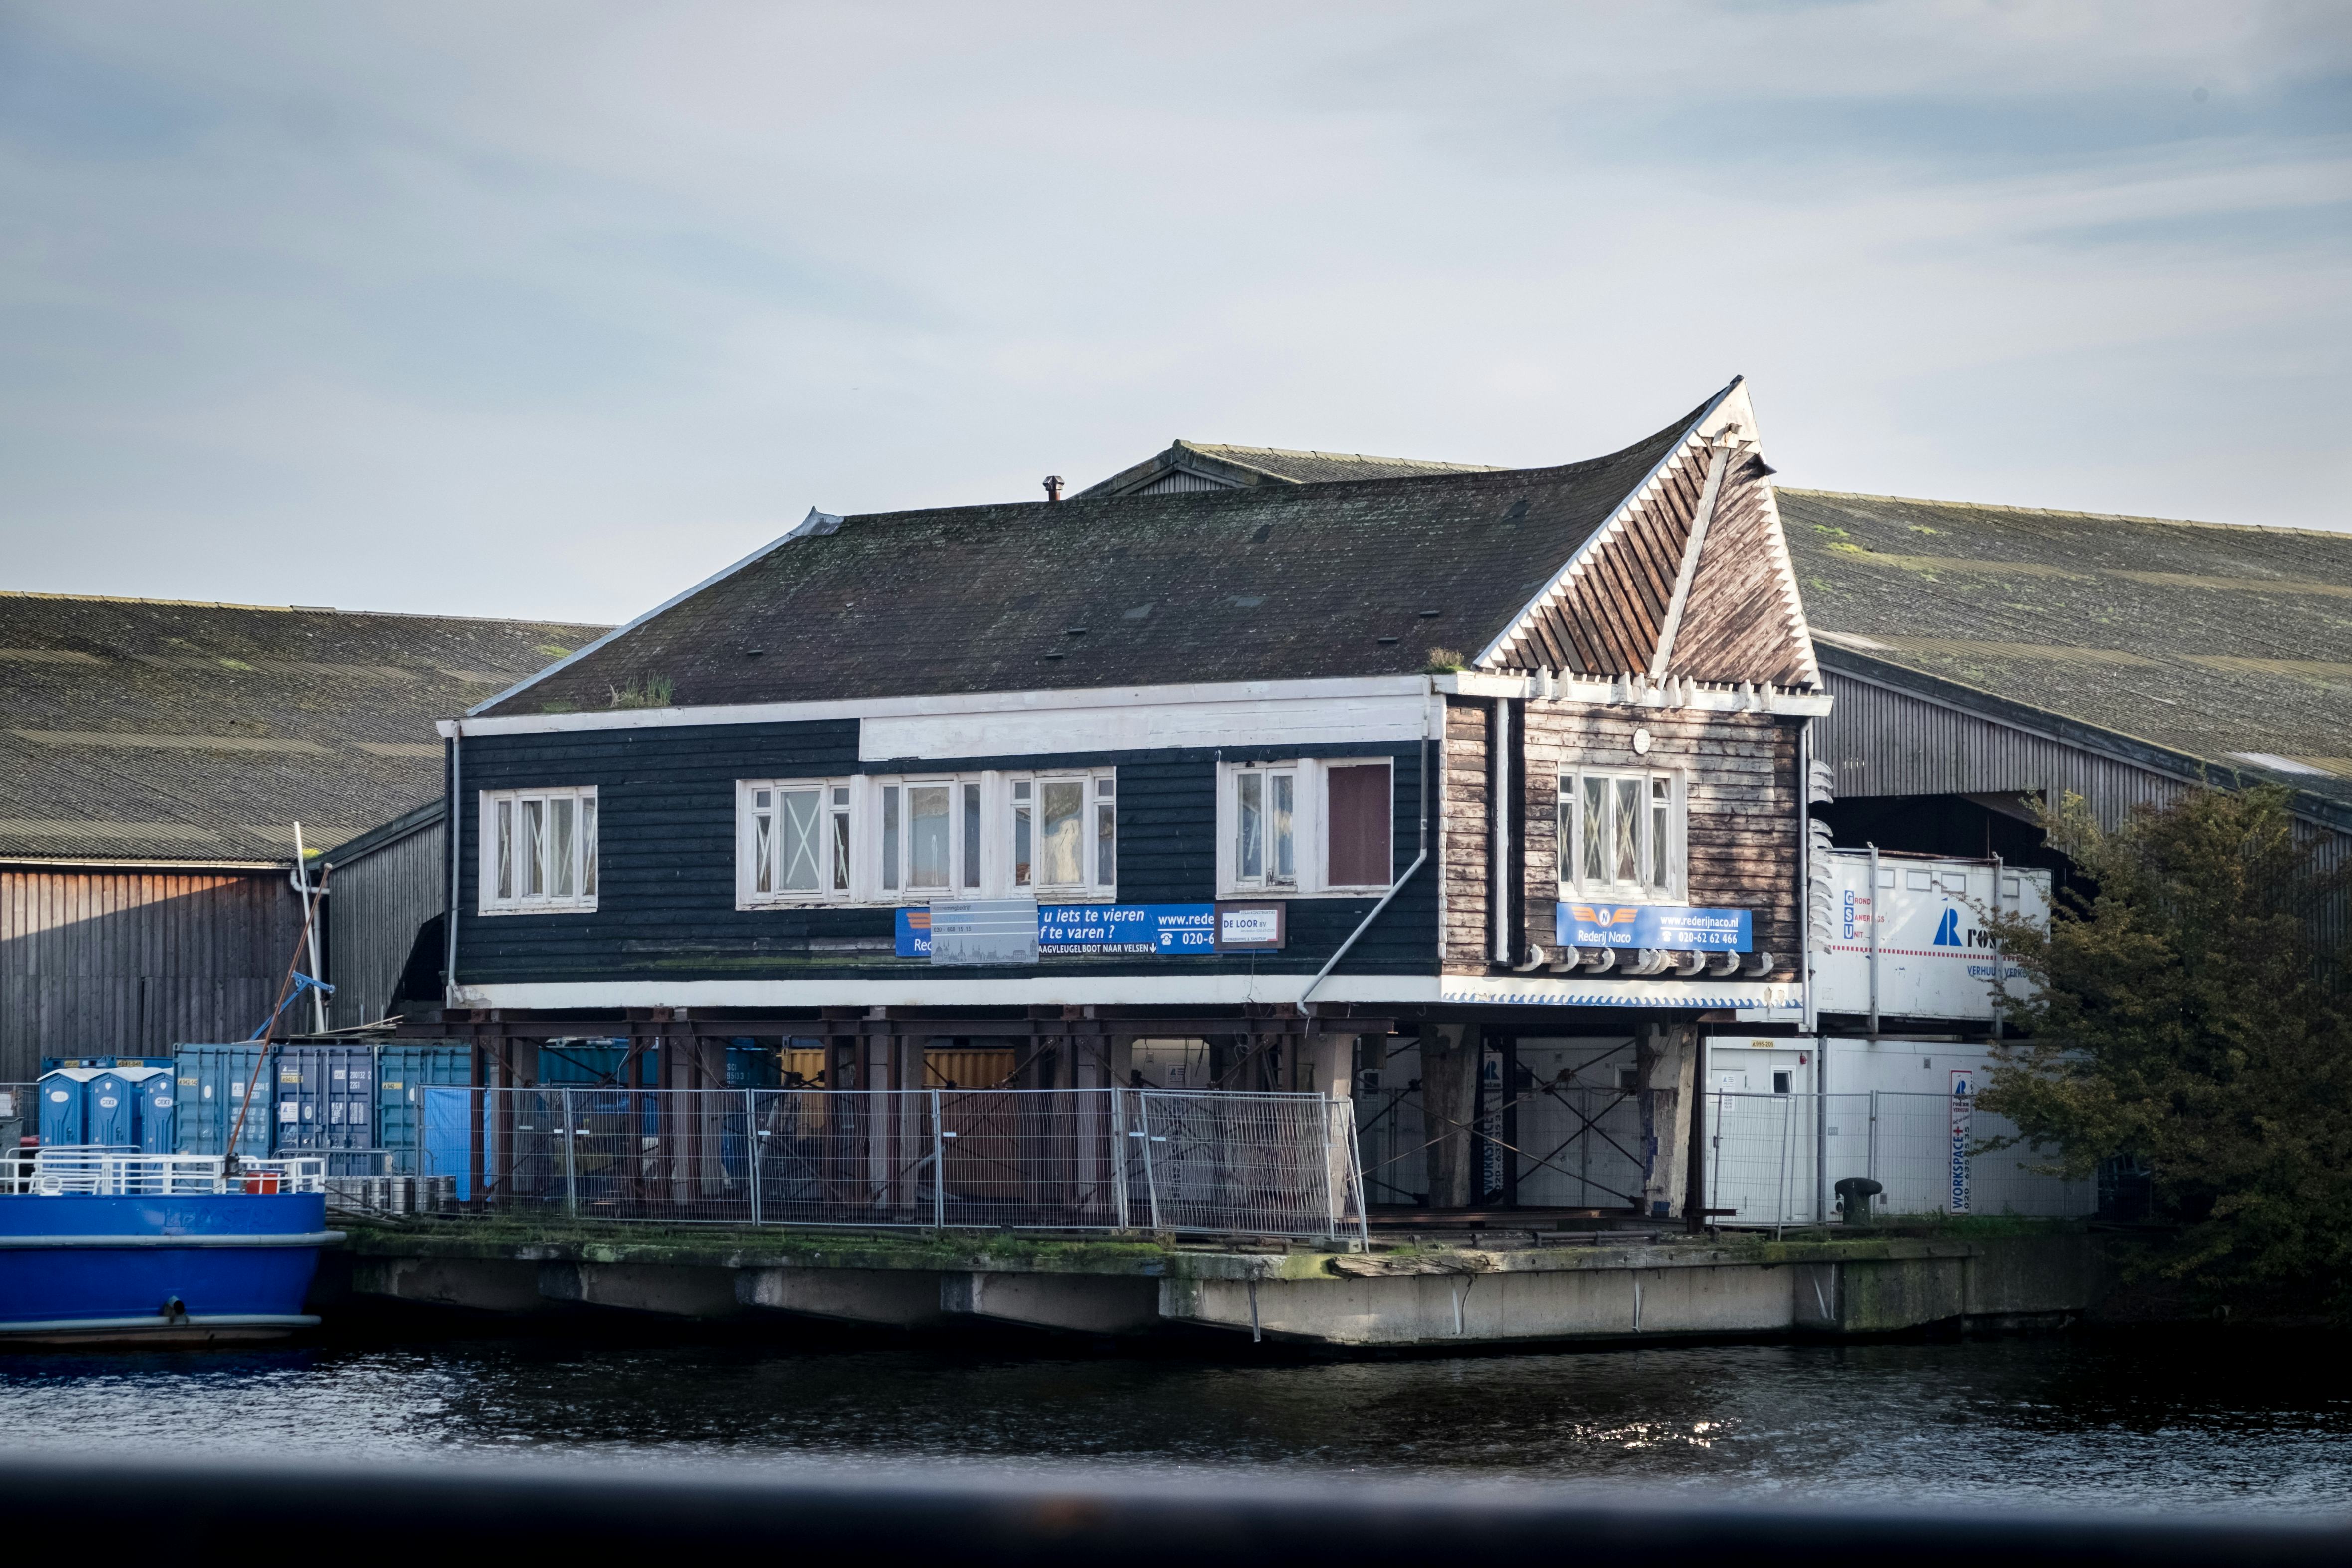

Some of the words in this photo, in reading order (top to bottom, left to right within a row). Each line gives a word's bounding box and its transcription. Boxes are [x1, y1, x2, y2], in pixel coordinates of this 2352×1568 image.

[1044, 912, 1052, 922] u
[1056, 909, 1081, 923] iets
[1085, 909, 1098, 922] te
[1103, 908, 1145, 922] vieren
[1602, 913, 1608, 923] N
[1845, 908, 1884, 923] SANERGS
[1236, 919, 1258, 928] LOOR
[1660, 916, 1739, 929] www.rederijnaco.nl
[1050, 926, 1063, 939] te
[1068, 927, 1104, 939] varen
[1109, 925, 1115, 939] ?
[1578, 930, 1607, 946] Rederij
[1609, 931, 1631, 943] Naco
[1678, 931, 1707, 943] 020-62
[1710, 933, 1720, 944] 62
[1722, 933, 1738, 944] 466
[1182, 933, 1214, 945] 020-6
[1103, 944, 1122, 953] NAAR
[1124, 944, 1149, 953] VELSEN
[1967, 965, 2001, 976] VERHUU
